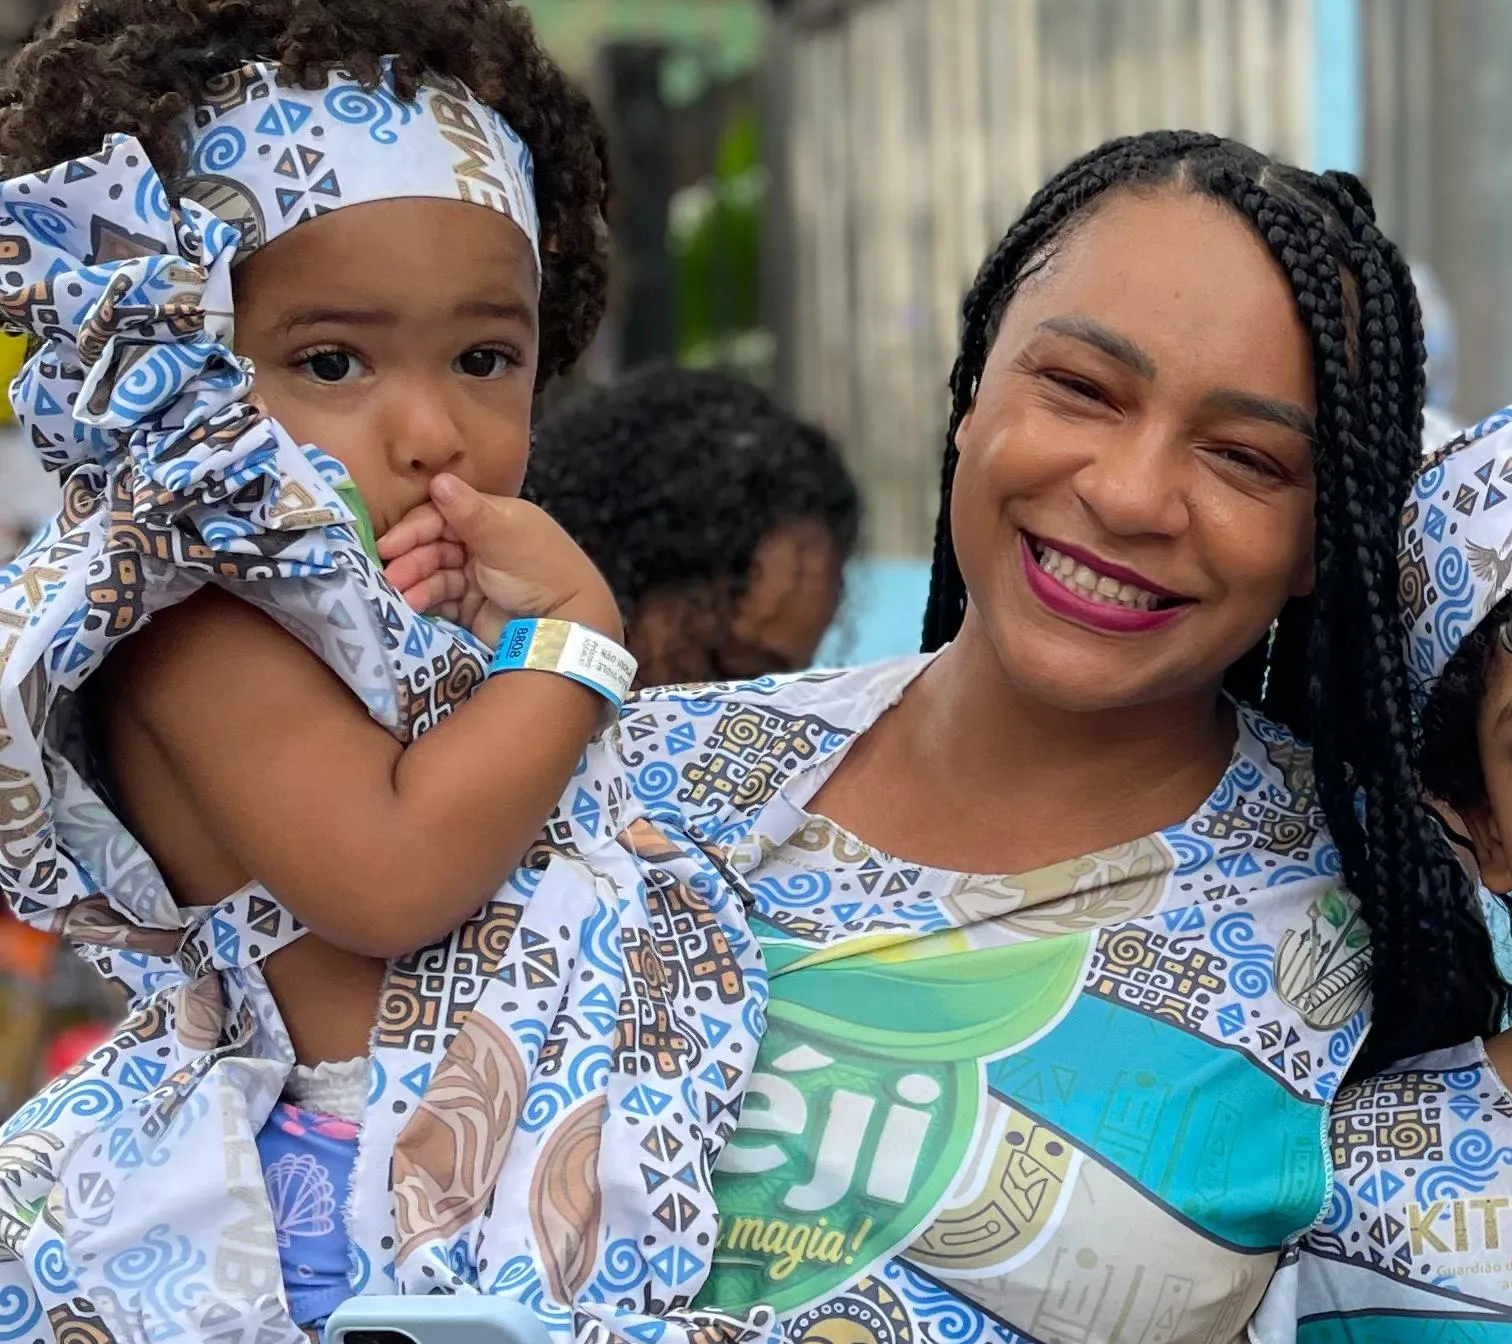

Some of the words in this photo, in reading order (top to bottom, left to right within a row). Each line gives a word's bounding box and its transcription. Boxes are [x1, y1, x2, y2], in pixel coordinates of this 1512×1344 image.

[711, 1044, 941, 1211] éji
[727, 1217, 872, 1281] magia!
[1436, 1261, 1501, 1278] Guardião
